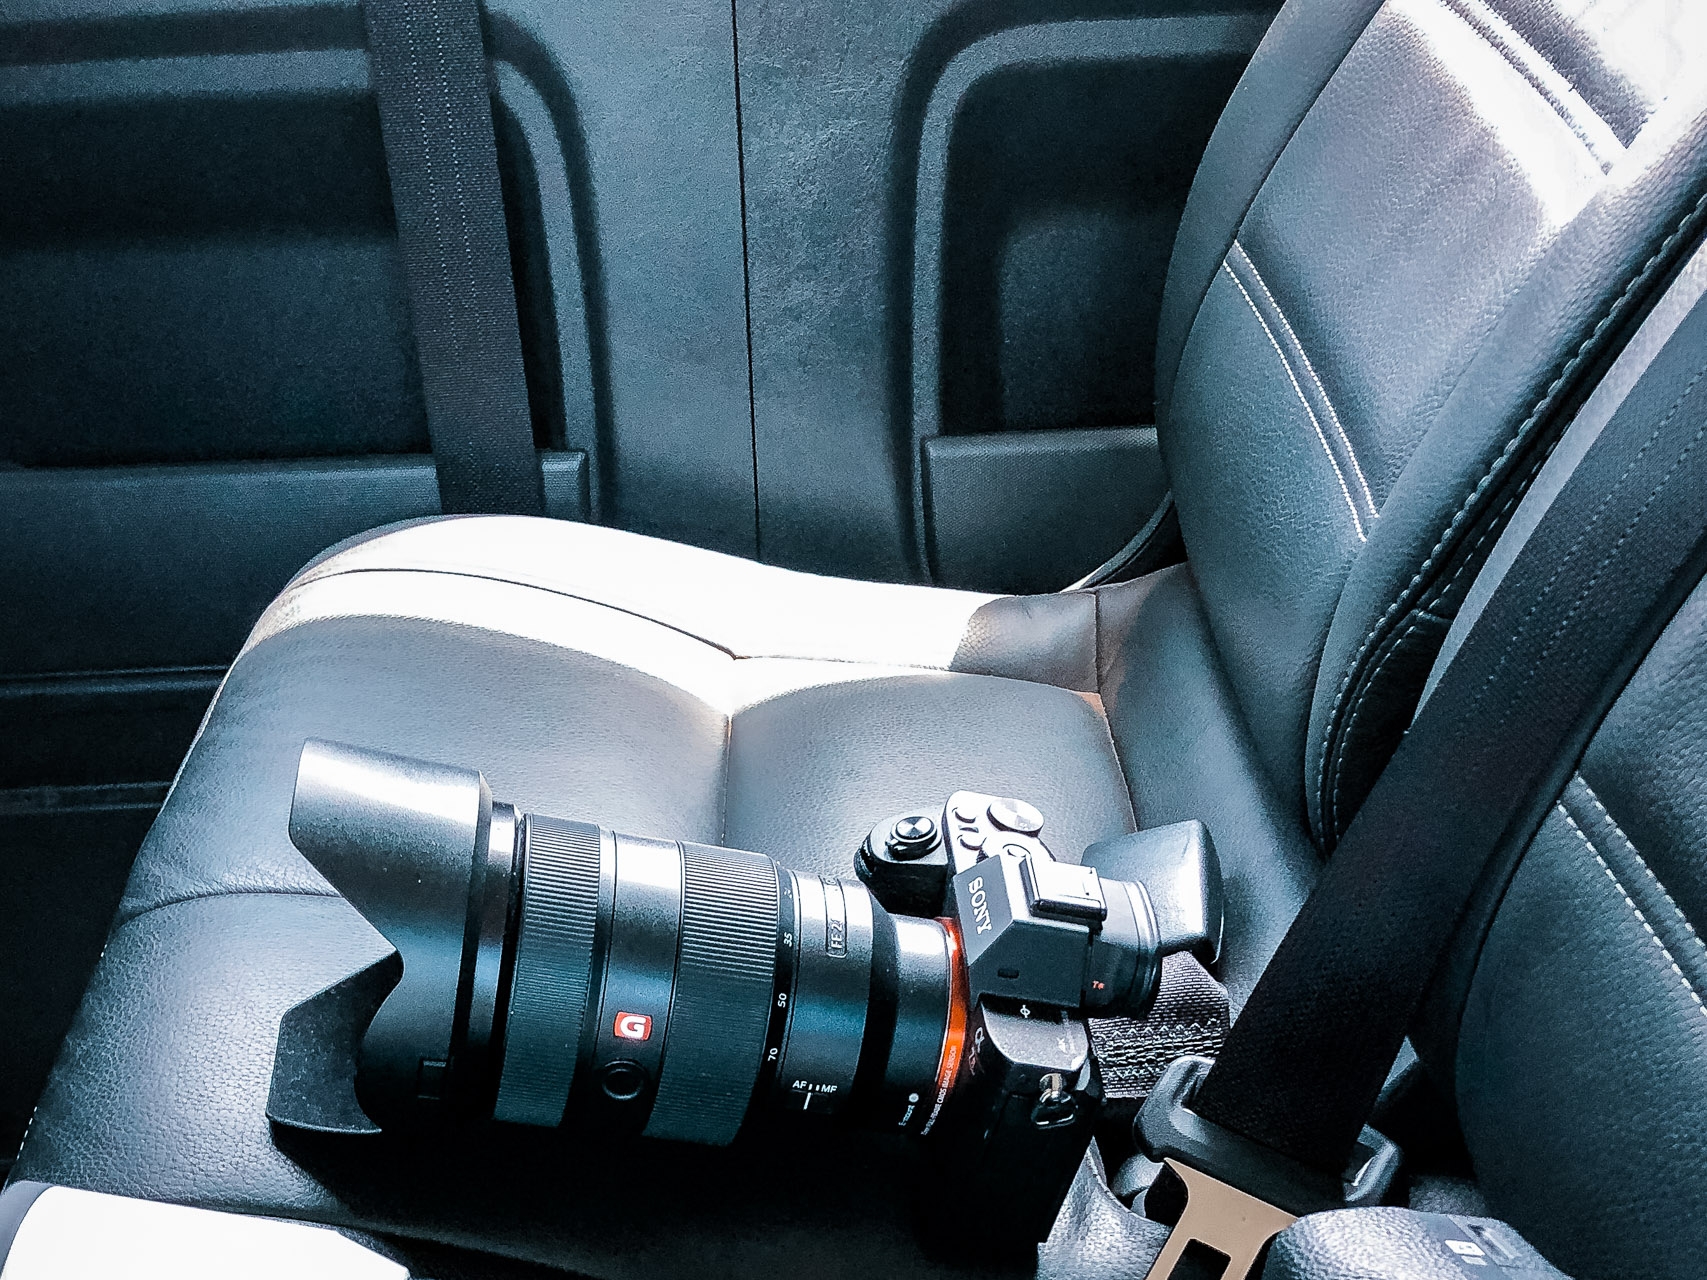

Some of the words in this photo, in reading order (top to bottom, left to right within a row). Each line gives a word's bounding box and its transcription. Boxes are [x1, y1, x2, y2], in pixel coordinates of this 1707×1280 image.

[968, 876, 993, 935] SONY
[783, 932, 793, 948] 35
[777, 992, 788, 1008] 50
[620, 1015, 647, 1040] G
[767, 1047, 779, 1062] 70
[792, 1080, 807, 1089] AF
[821, 1084, 838, 1093] MF
